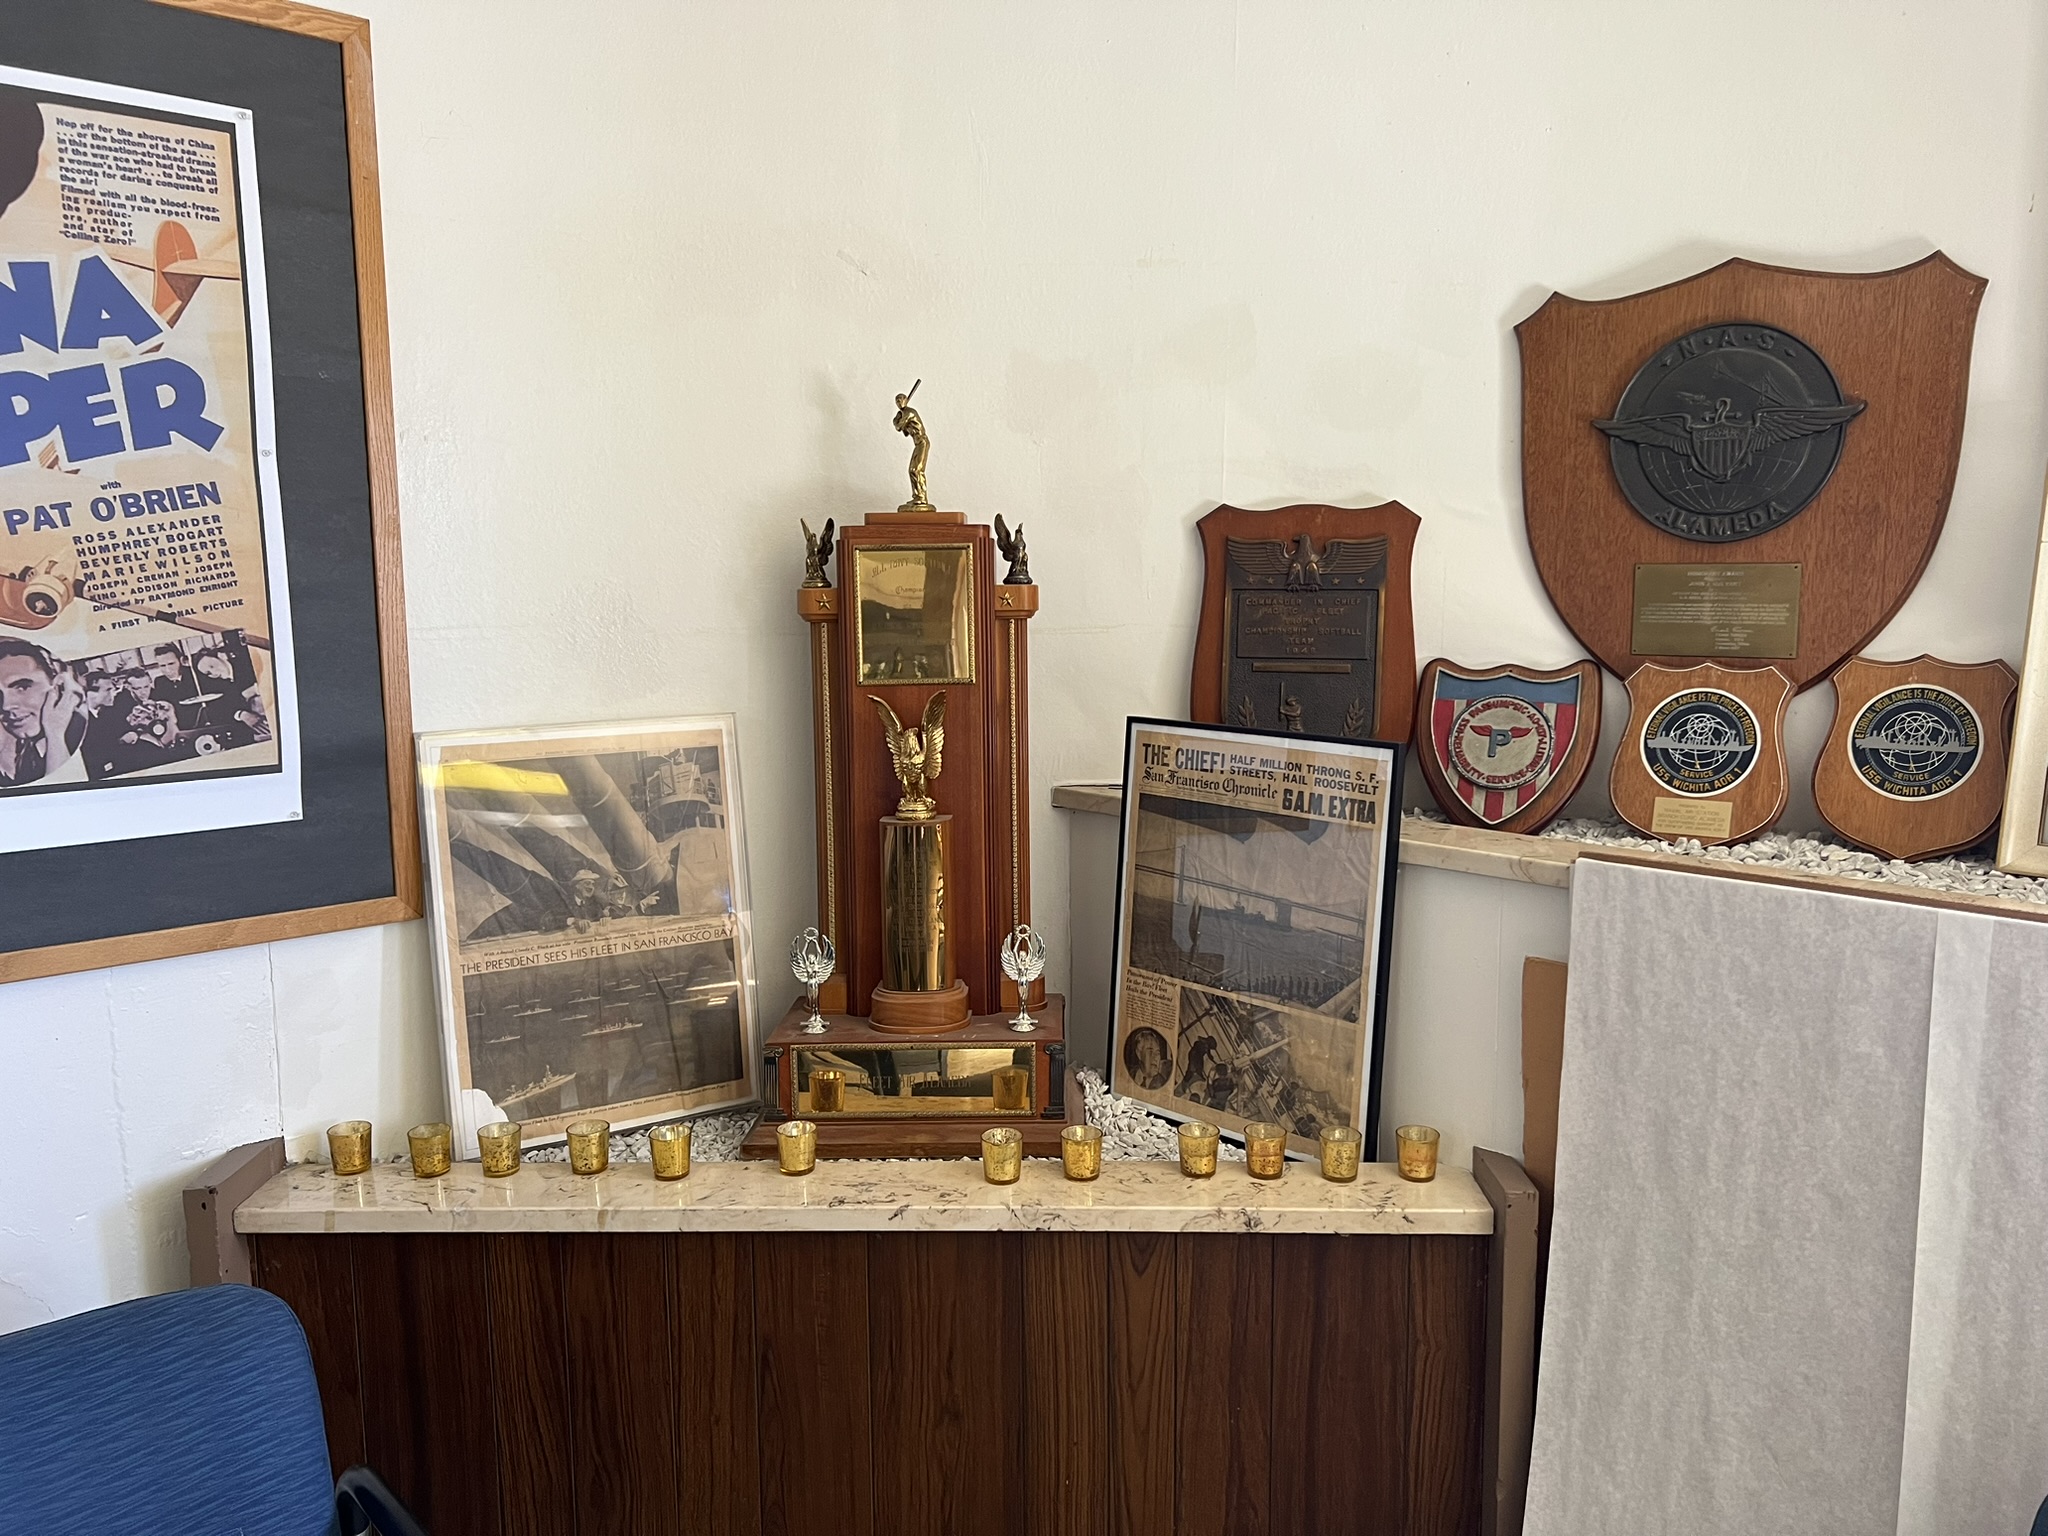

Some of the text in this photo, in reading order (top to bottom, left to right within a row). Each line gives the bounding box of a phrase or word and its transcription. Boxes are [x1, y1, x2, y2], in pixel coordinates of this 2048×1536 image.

[56, 117, 215, 150] Hop off for the shores of China
[91, 133, 106, 143] the
[111, 135, 145, 148] bottom
[150, 141, 159, 150] of
[162, 143, 177, 153] the
[180, 147, 197, 156] sea
[58, 146, 69, 154] of
[72, 148, 87, 157] the
[91, 152, 109, 160] war
[113, 155, 130, 163] ace
[134, 156, 153, 167] who
[156, 160, 173, 170] had
[189, 165, 216, 176] break
[69, 139, 216, 167] this sensation-streaked drama
[60, 166, 218, 194] records for daring conquests of
[68, 158, 112, 170] woman's
[116, 164, 142, 174] heart
[163, 171, 173, 179] to
[176, 172, 204, 183] break
[206, 177, 217, 185] all
[61, 185, 95, 196] Filmed
[99, 190, 121, 199] with
[125, 192, 136, 201] all
[141, 195, 156, 204] the
[62, 195, 220, 222] ing realism you expect from
[64, 223, 133, 237] and star of
[100, 480, 122, 491] with
[4, 481, 222, 536] PAT O'BRIEN
[1656, 501, 1788, 537] ALAMEDA
[72, 515, 222, 545] ROSS ALEXANDER
[76, 526, 224, 557] HUMPHREY BOGART
[80, 538, 228, 569] BEVERLY ROBERTS
[84, 550, 232, 582] MARIE WILSON
[87, 561, 233, 592] JOSEPH CREHAN JOSEPH
[89, 570, 236, 602] KING ADDISON RICHARDS
[148, 588, 195, 602] RAYMOND
[200, 580, 238, 593] ENRIGHT
[111, 618, 140, 629] FIRST
[202, 599, 244, 612] PICTURE
[1246, 598, 1302, 606] COMMANDER
[1245, 627, 1307, 635] CHAMPIONSHIP
[1646, 693, 1755, 744] ETERNAL VIGILANCE IS THE PRICE FREEDOM
[1855, 708, 1875, 738] ETERNAL
[1873, 689, 1912, 711] VIGILANCE
[1923, 690, 1938, 699] THE
[1938, 693, 1958, 708] PRICE
[1955, 706, 1966, 718] OF
[1962, 716, 1977, 745] FREEDOM
[1142, 743, 1225, 774] THE CHIEF!
[1229, 754, 1379, 784] HALF MILLION THRONG S. F.
[1680, 768, 1714, 778] SERVICE
[1142, 766, 1164, 783] San
[1165, 769, 1220, 791] Francisco
[1222, 778, 1277, 800] Chronicle
[1229, 766, 1379, 796] STREETS, HAIL ROOSEVELT
[1653, 763, 1670, 782] USS
[1672, 778, 1711, 792] WICHITA
[1862, 765, 1882, 785] USS
[1883, 781, 1928, 796] WICHITA
[1954, 769, 1963, 777] 1
[1893, 771, 1930, 781] SERVICE
[1328, 795, 1376, 824] EXTRA
[460, 962, 481, 974] THE
[486, 954, 540, 971] PRESIDENT
[544, 950, 567, 962] SEES
[571, 948, 587, 959] HIS
[591, 943, 618, 956] FLEET
[621, 942, 631, 952] IN
[634, 938, 656, 950] SAN
[659, 931, 711, 946] FRANCISCO
[714, 927, 733, 938] BAY
[1149, 991, 1172, 1002] President
[1161, 978, 1177, 987] Power
[859, 1074, 892, 1091] FLEET
